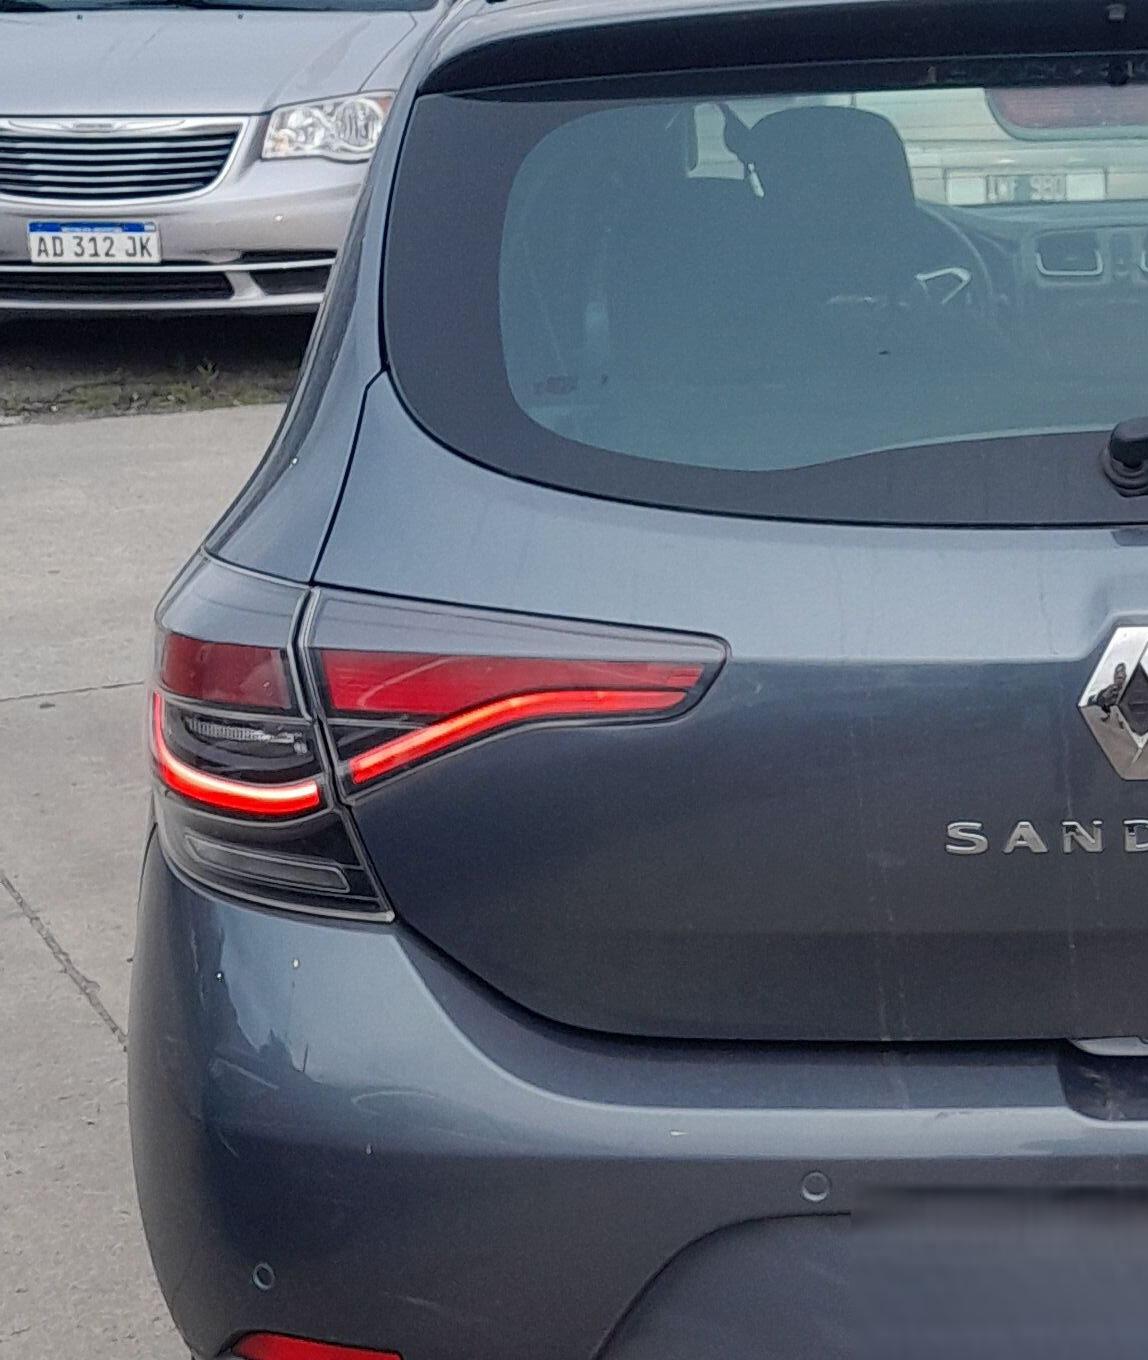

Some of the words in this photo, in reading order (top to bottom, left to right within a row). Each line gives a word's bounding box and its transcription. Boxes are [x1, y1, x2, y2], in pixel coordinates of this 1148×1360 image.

[37, 236, 64, 258] AD
[73, 236, 115, 258] 312
[125, 236, 152, 258] JK
